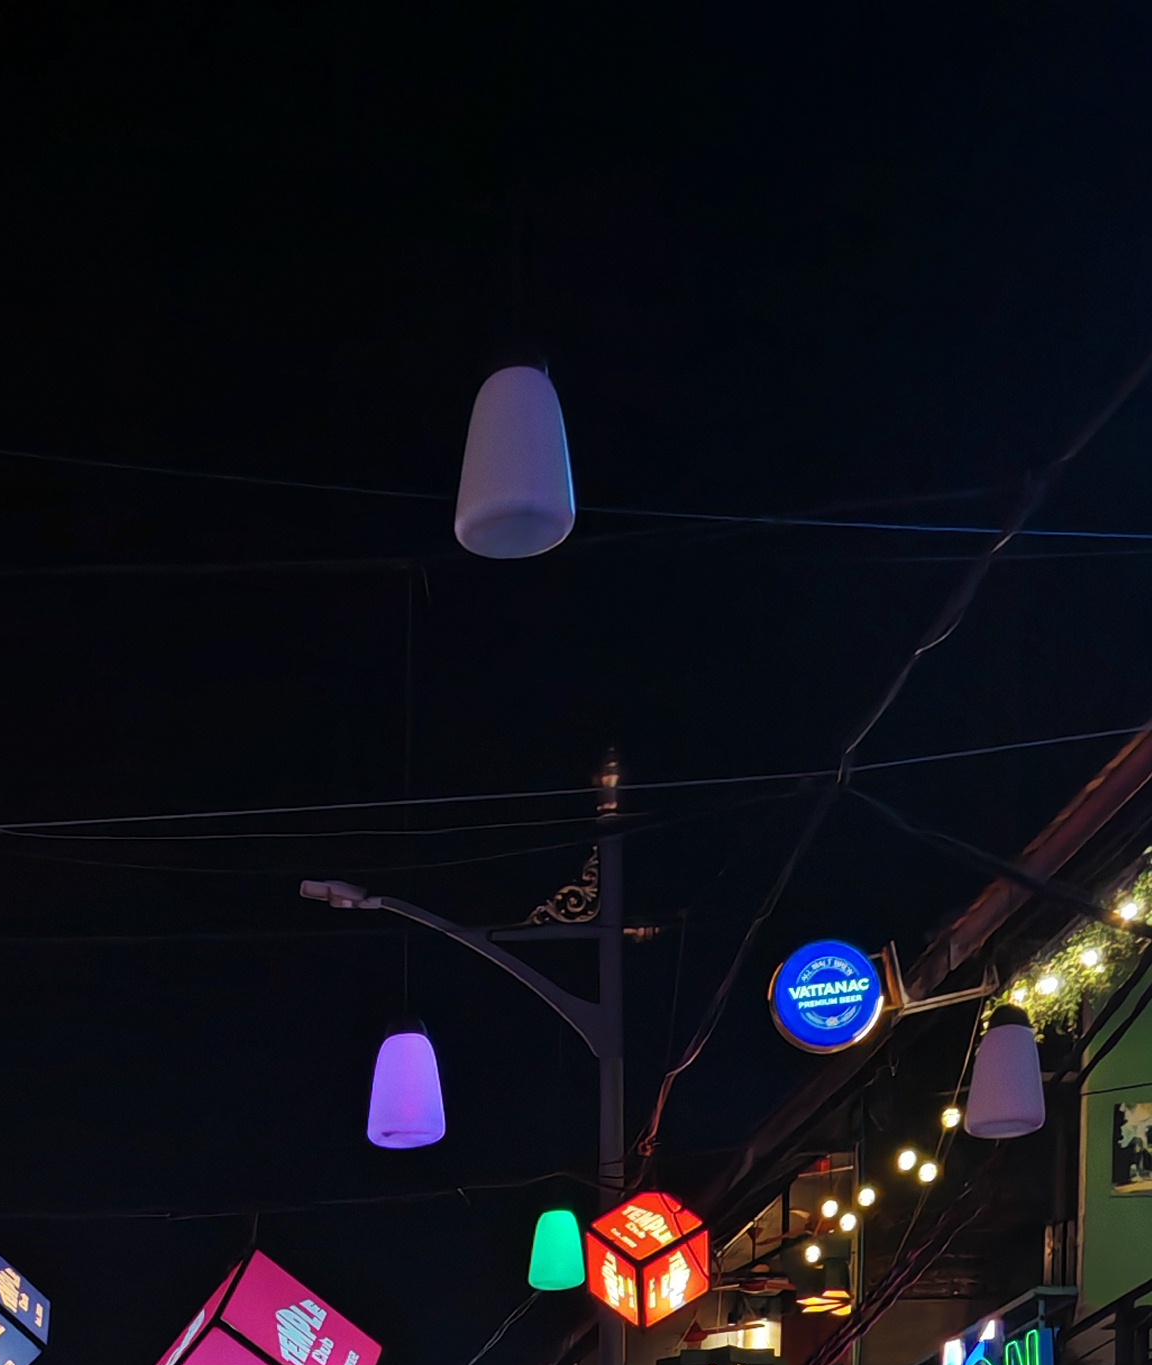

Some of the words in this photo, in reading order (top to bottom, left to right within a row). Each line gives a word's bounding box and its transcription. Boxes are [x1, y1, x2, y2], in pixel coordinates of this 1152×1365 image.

[788, 977, 869, 1000] VATTANAC
[798, 998, 837, 1009] PREMIUM
[839, 994, 862, 1004] BEER
[311, 1337, 335, 1365] Club
